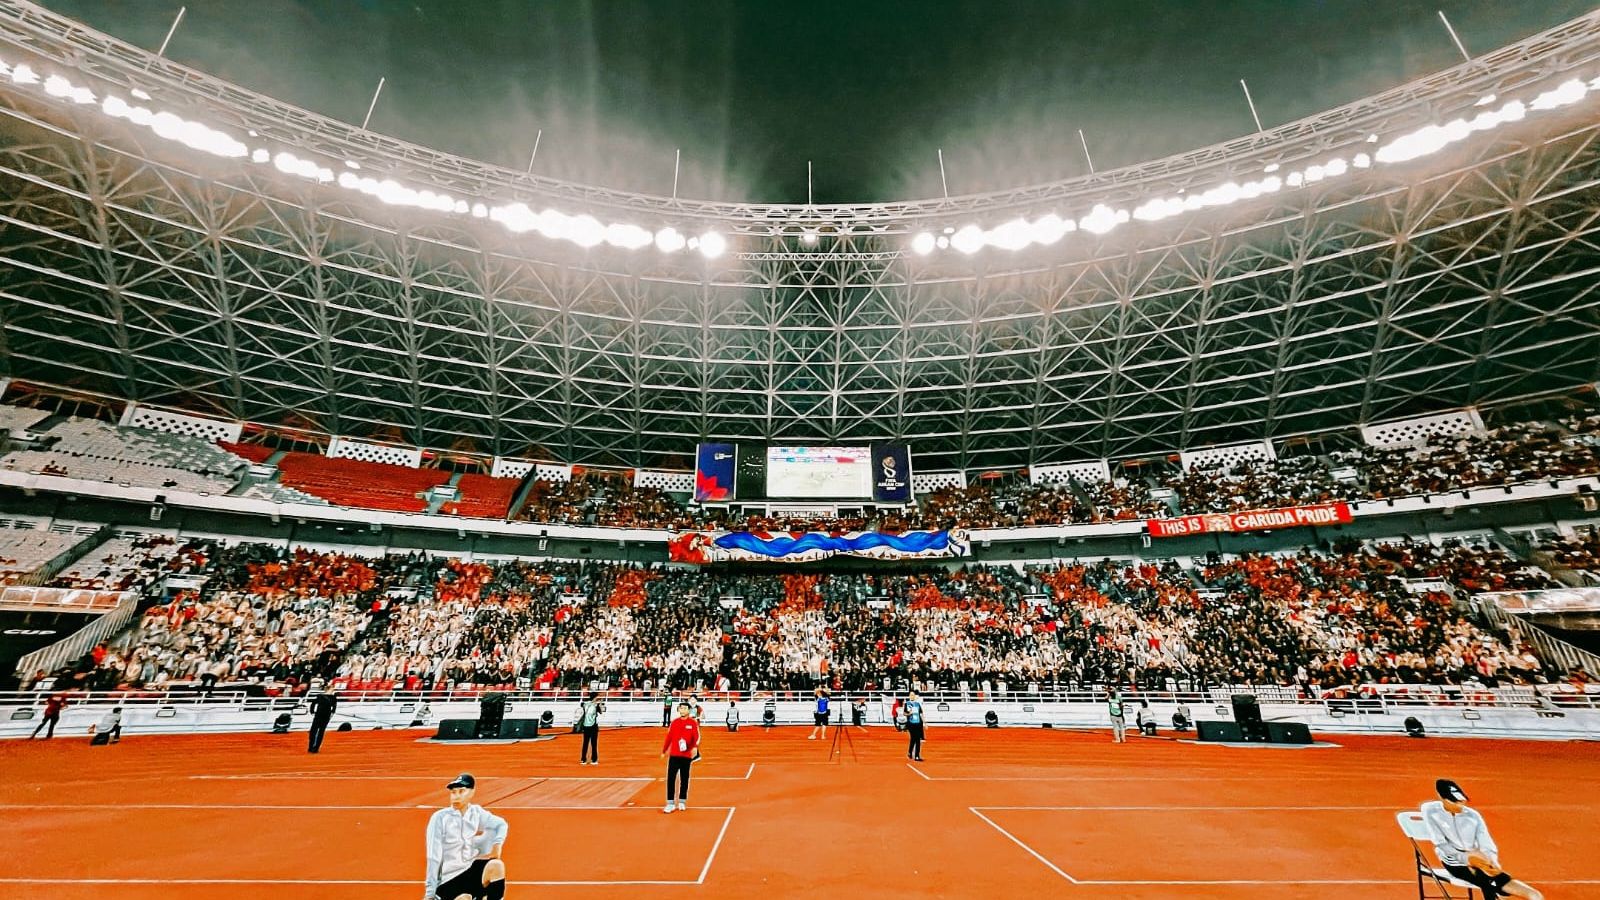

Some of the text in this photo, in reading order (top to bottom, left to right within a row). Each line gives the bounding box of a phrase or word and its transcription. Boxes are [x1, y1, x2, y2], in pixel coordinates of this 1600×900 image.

[1159, 507, 1339, 535] THIS IS GARUDA PRIDE
